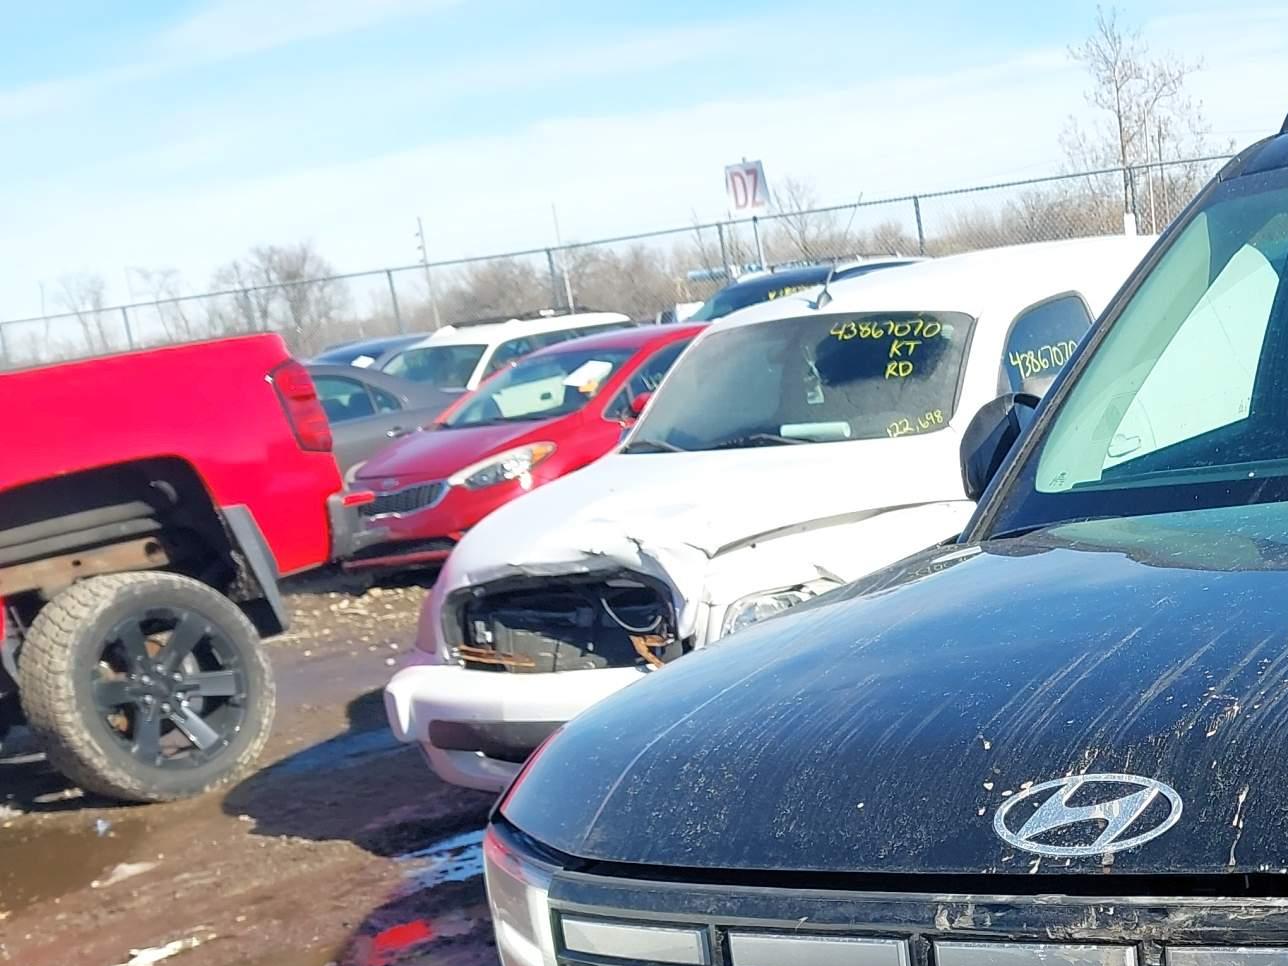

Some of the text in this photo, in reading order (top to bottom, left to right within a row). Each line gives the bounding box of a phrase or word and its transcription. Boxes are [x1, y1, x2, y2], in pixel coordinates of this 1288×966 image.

[830, 319, 941, 341] 43867070
[889, 339, 922, 358] KT
[885, 360, 913, 379] RD
